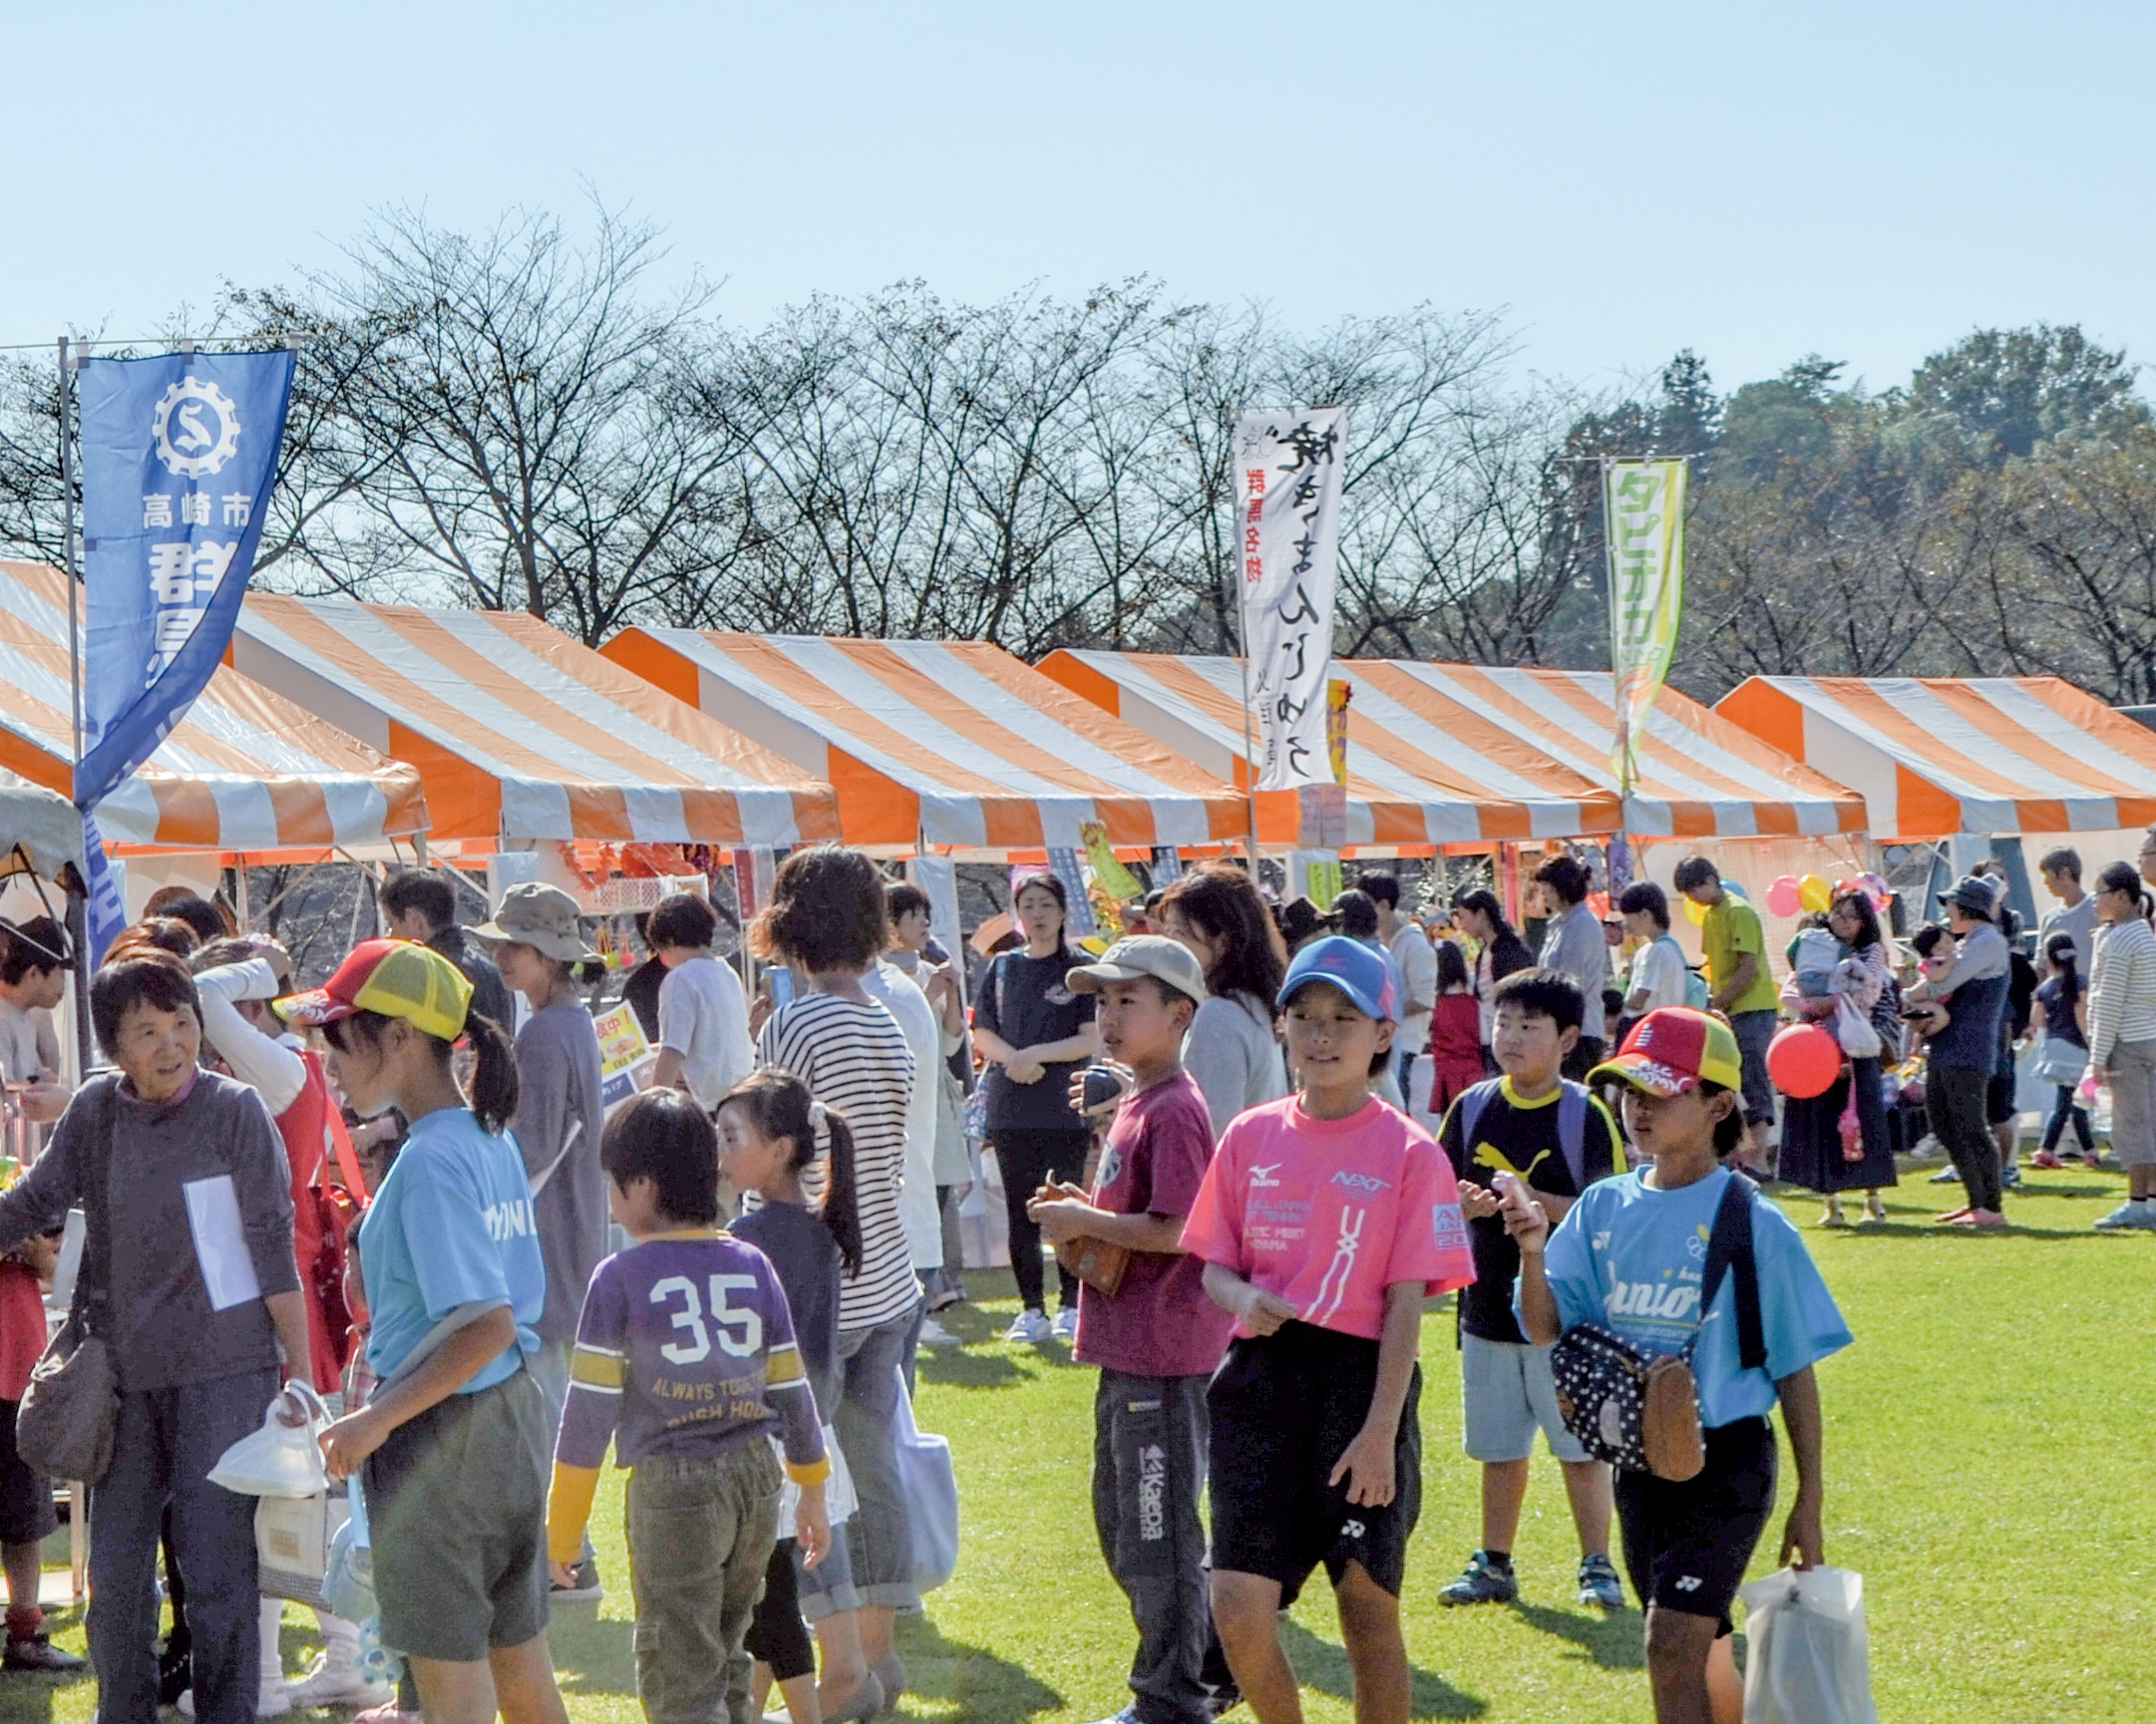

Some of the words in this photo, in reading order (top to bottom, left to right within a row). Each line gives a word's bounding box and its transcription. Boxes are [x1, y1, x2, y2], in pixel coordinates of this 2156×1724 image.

[142, 491, 252, 529] 高崎市
[1617, 471, 1662, 647] タピオカ
[649, 1273, 763, 1366] 35
[651, 1377, 716, 1402] ALWAYS
